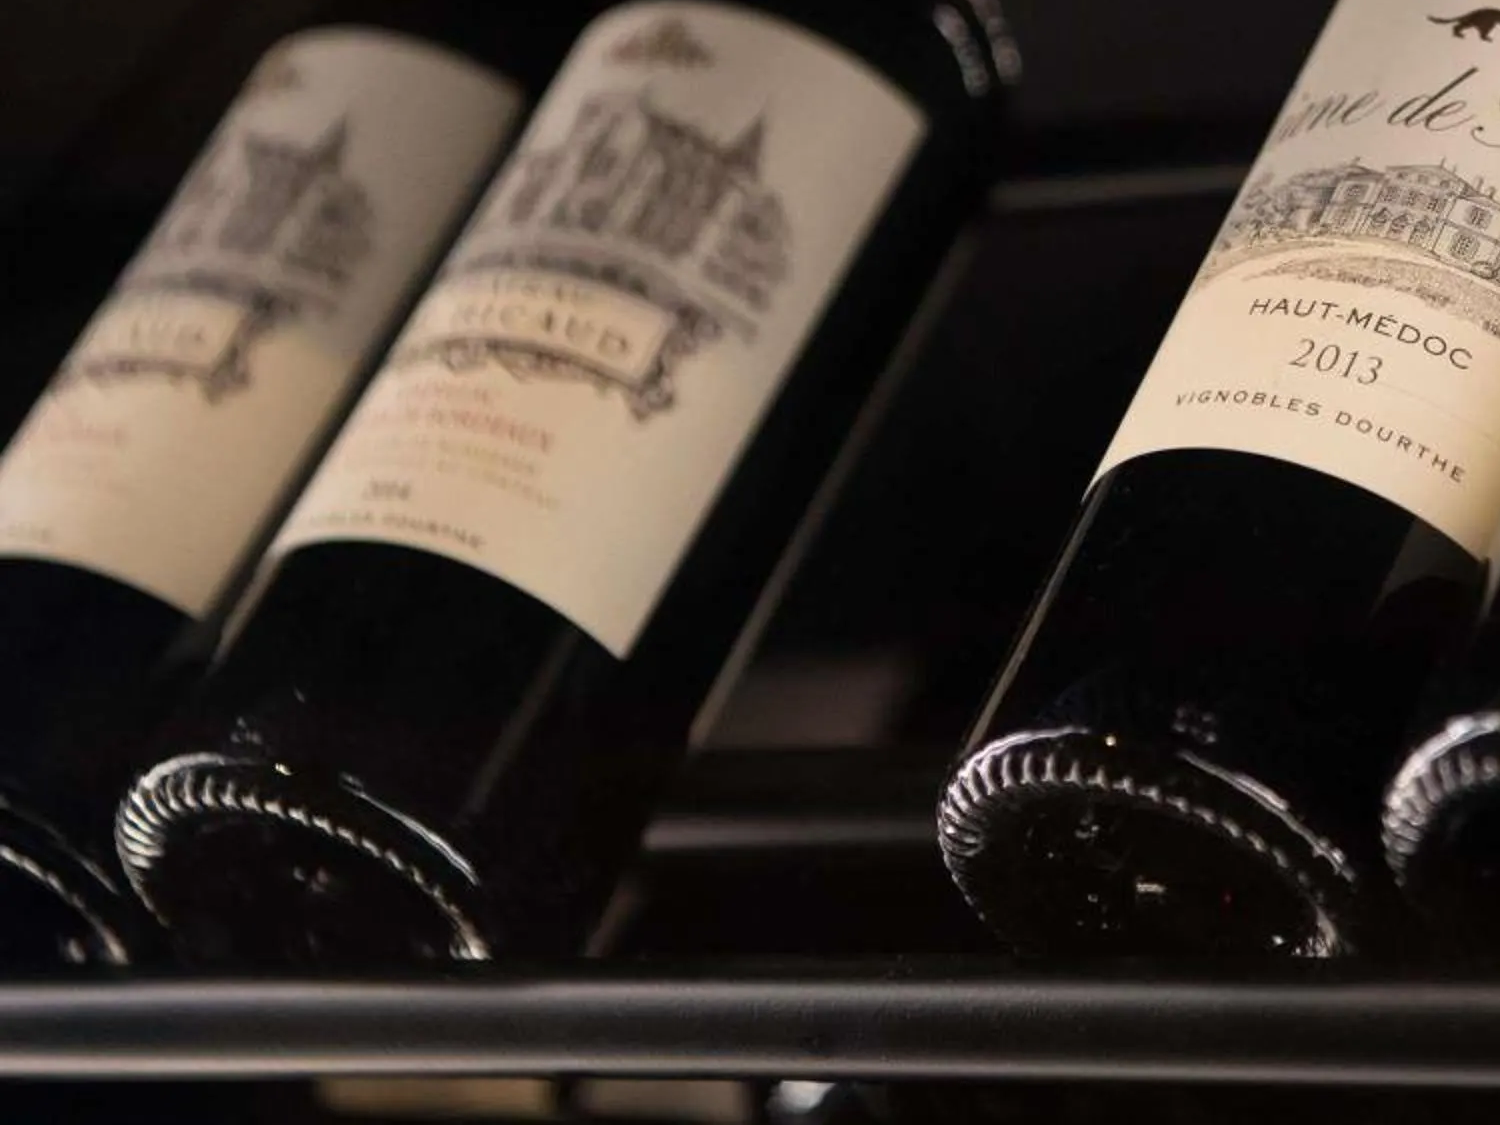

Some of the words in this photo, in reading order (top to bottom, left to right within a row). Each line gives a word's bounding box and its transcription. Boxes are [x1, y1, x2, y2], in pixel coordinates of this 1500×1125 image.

[1386, 66, 1479, 132] de
[1249, 297, 1474, 371] HAUT-MÉDOC
[1289, 337, 1384, 386] 2013
[1175, 389, 1322, 418] VIGNOBLES
[1335, 409, 1468, 484] DOURTHE
